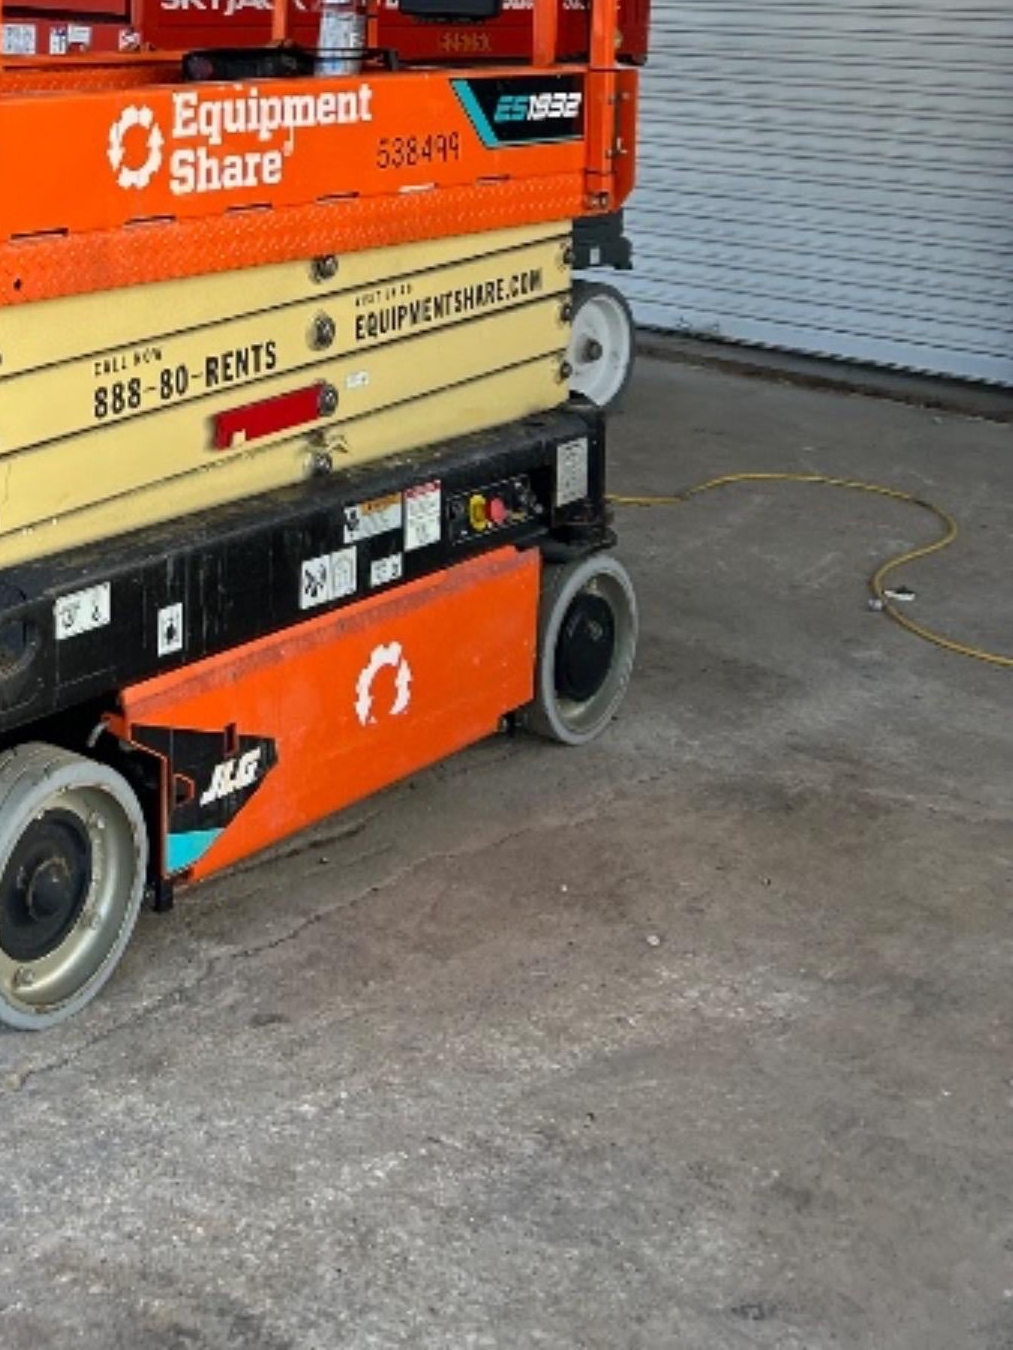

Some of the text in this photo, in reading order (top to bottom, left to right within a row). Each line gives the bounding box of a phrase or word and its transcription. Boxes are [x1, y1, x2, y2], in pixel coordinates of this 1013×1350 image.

[172, 83, 373, 145] Equipment
[494, 92, 582, 123] ES1932
[169, 146, 282, 196] Share
[376, 131, 459, 169] 538499
[355, 266, 544, 341] EQUIPMENTSHARE.COM
[93, 339, 277, 419] 888-80-RENTS
[198, 746, 261, 807] JLG
